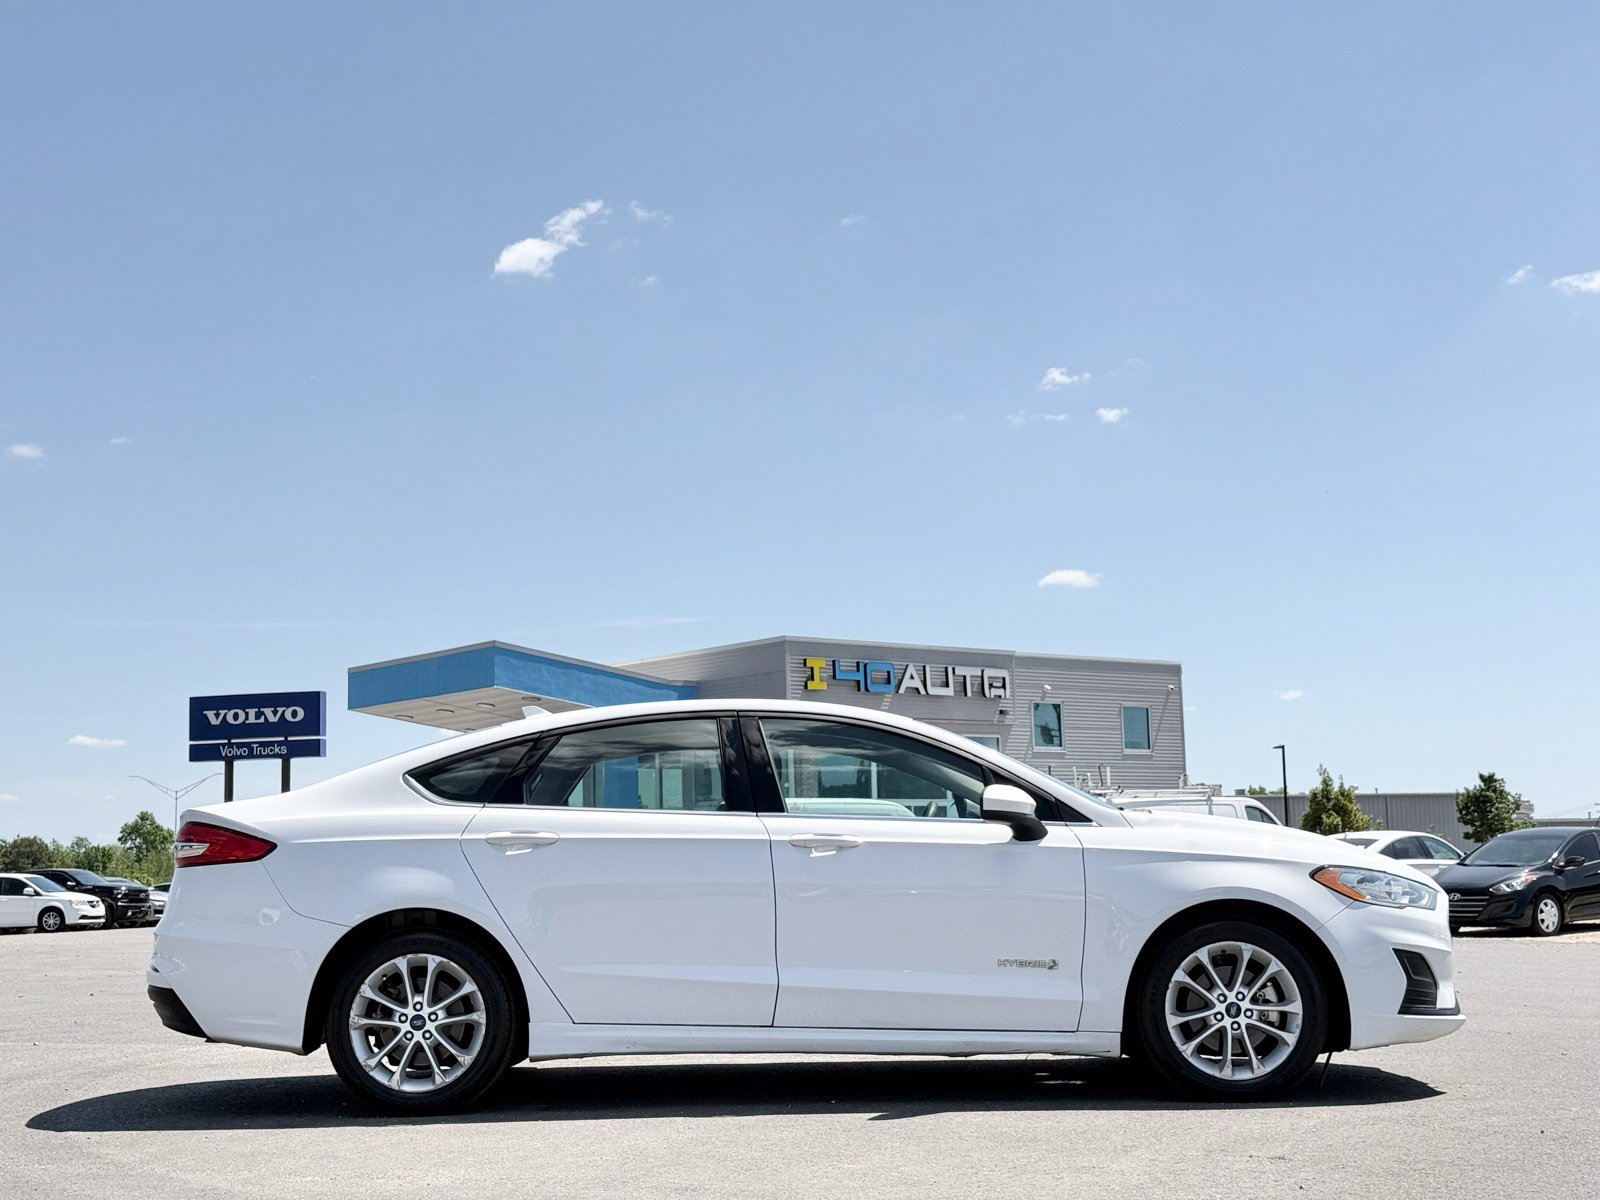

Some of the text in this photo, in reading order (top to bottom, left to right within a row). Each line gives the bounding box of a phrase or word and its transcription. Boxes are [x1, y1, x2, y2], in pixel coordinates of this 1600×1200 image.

[203, 706, 305, 726] VOLVO
[220, 743, 288, 757] Volvo Trucks
[997, 958, 1046, 969] HYBRID
